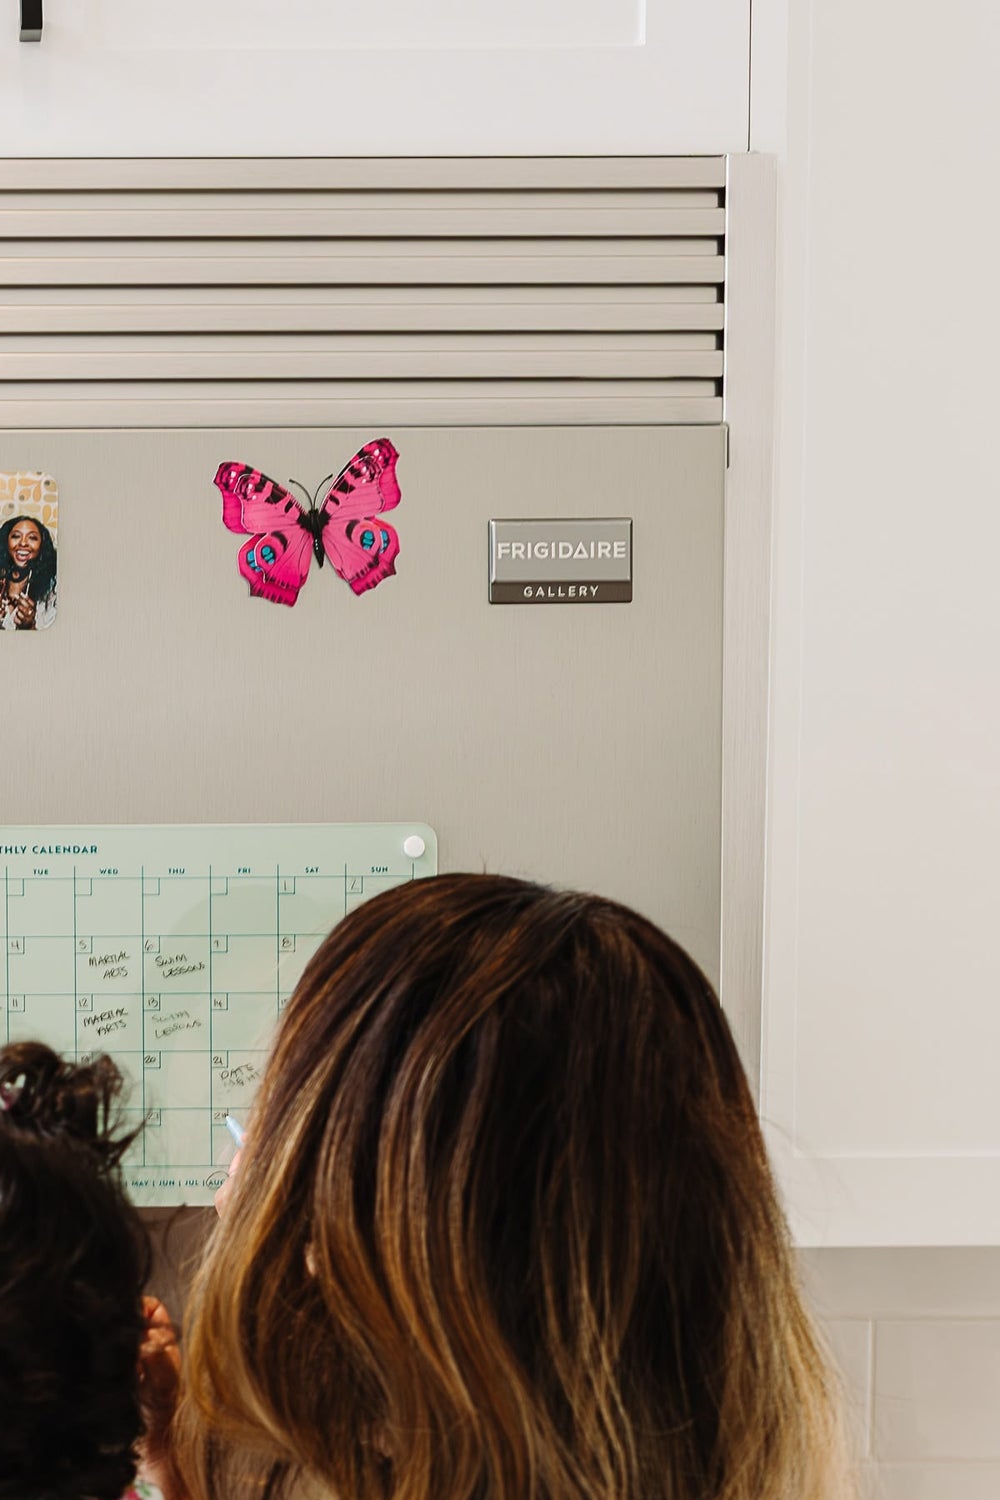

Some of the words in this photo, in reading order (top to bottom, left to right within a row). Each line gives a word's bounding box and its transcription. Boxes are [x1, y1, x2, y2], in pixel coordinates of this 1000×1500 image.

[497, 541, 627, 560] FRIGIDAIRE
[523, 585, 600, 598] GALLERY
[32, 845, 98, 854] CALENDAR
[305, 866, 320, 874] SAT
[11, 940, 20, 950] 4
[79, 940, 87, 950] 5
[144, 939, 153, 951] 6
[282, 937, 292, 948] 8
[12, 999, 18, 1007] 11
[79, 998, 88, 1008] 12
[147, 997, 158, 1008] 13
[144, 1055, 157, 1064] 20
